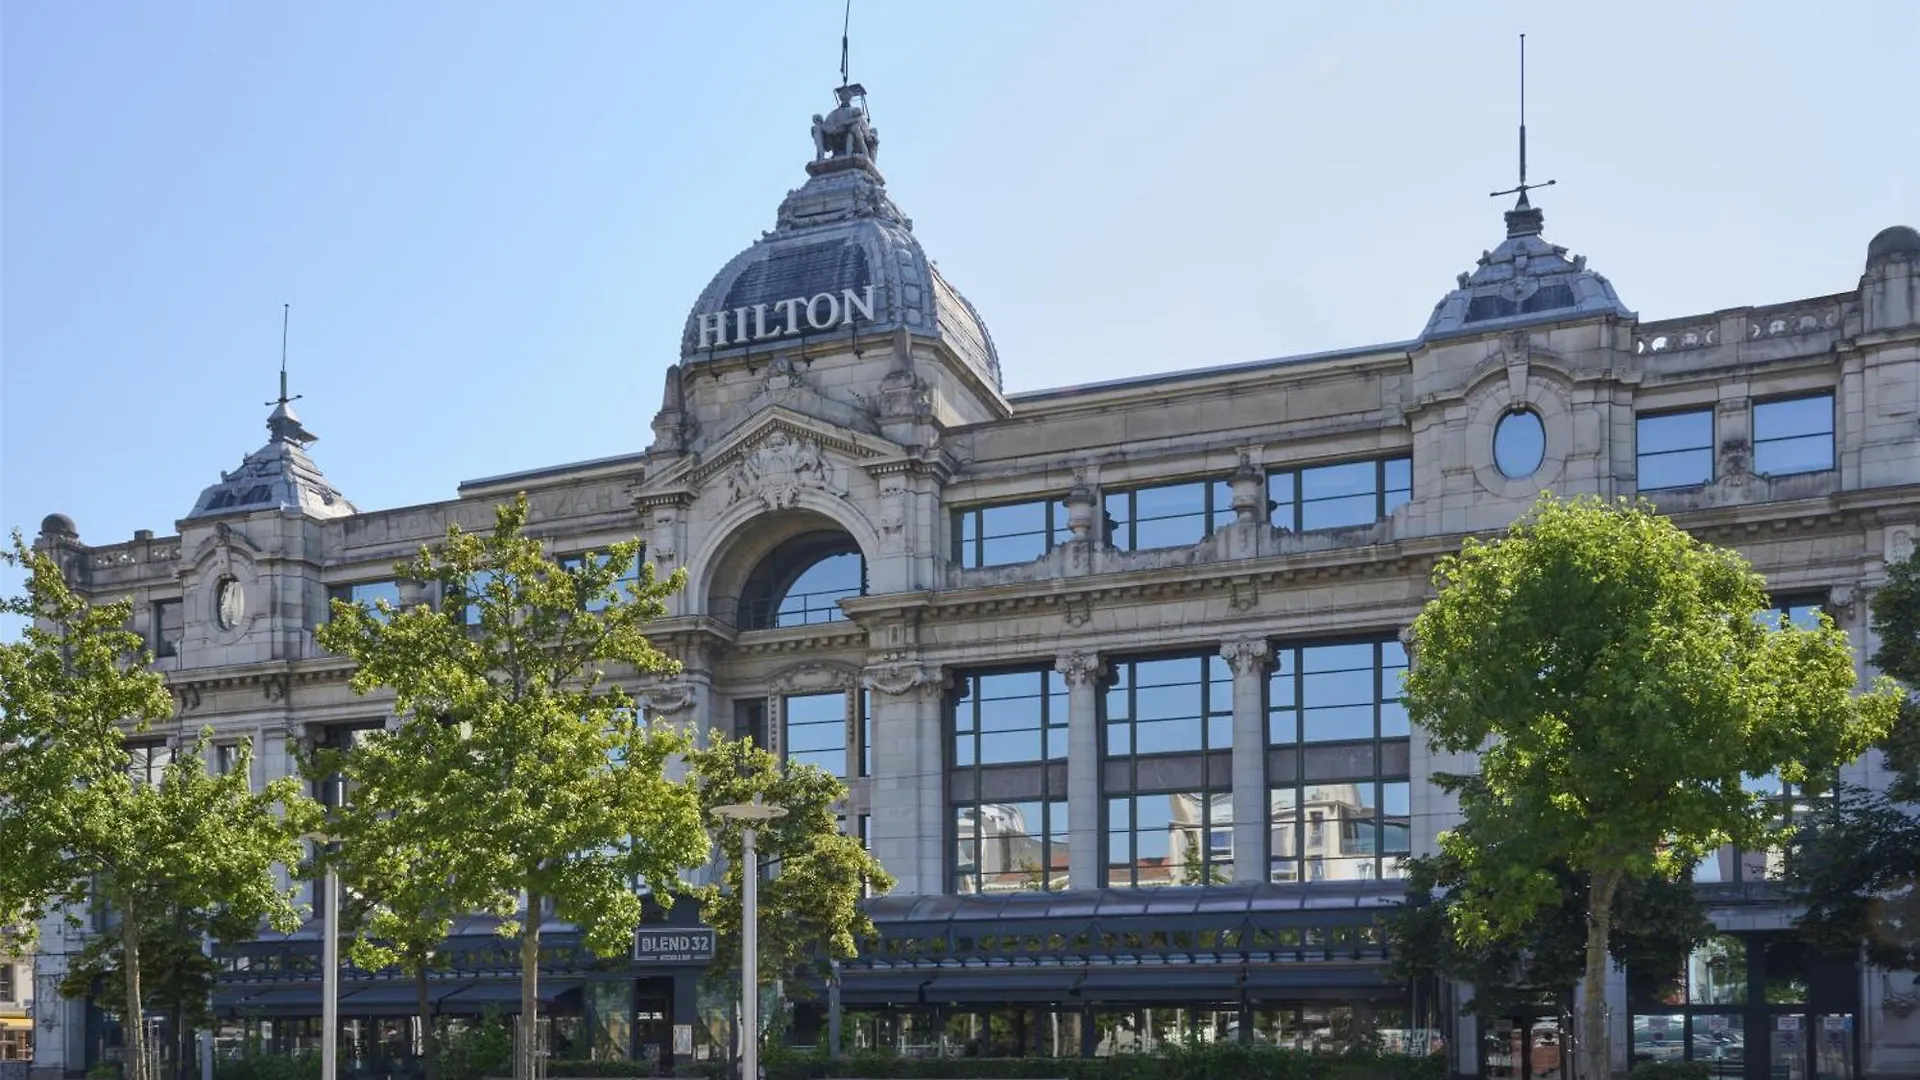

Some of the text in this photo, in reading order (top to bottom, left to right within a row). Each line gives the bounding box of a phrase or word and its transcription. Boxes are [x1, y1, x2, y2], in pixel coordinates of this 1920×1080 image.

[696, 285, 876, 349] HILTON
[642, 936, 709, 952] BLEND 32
